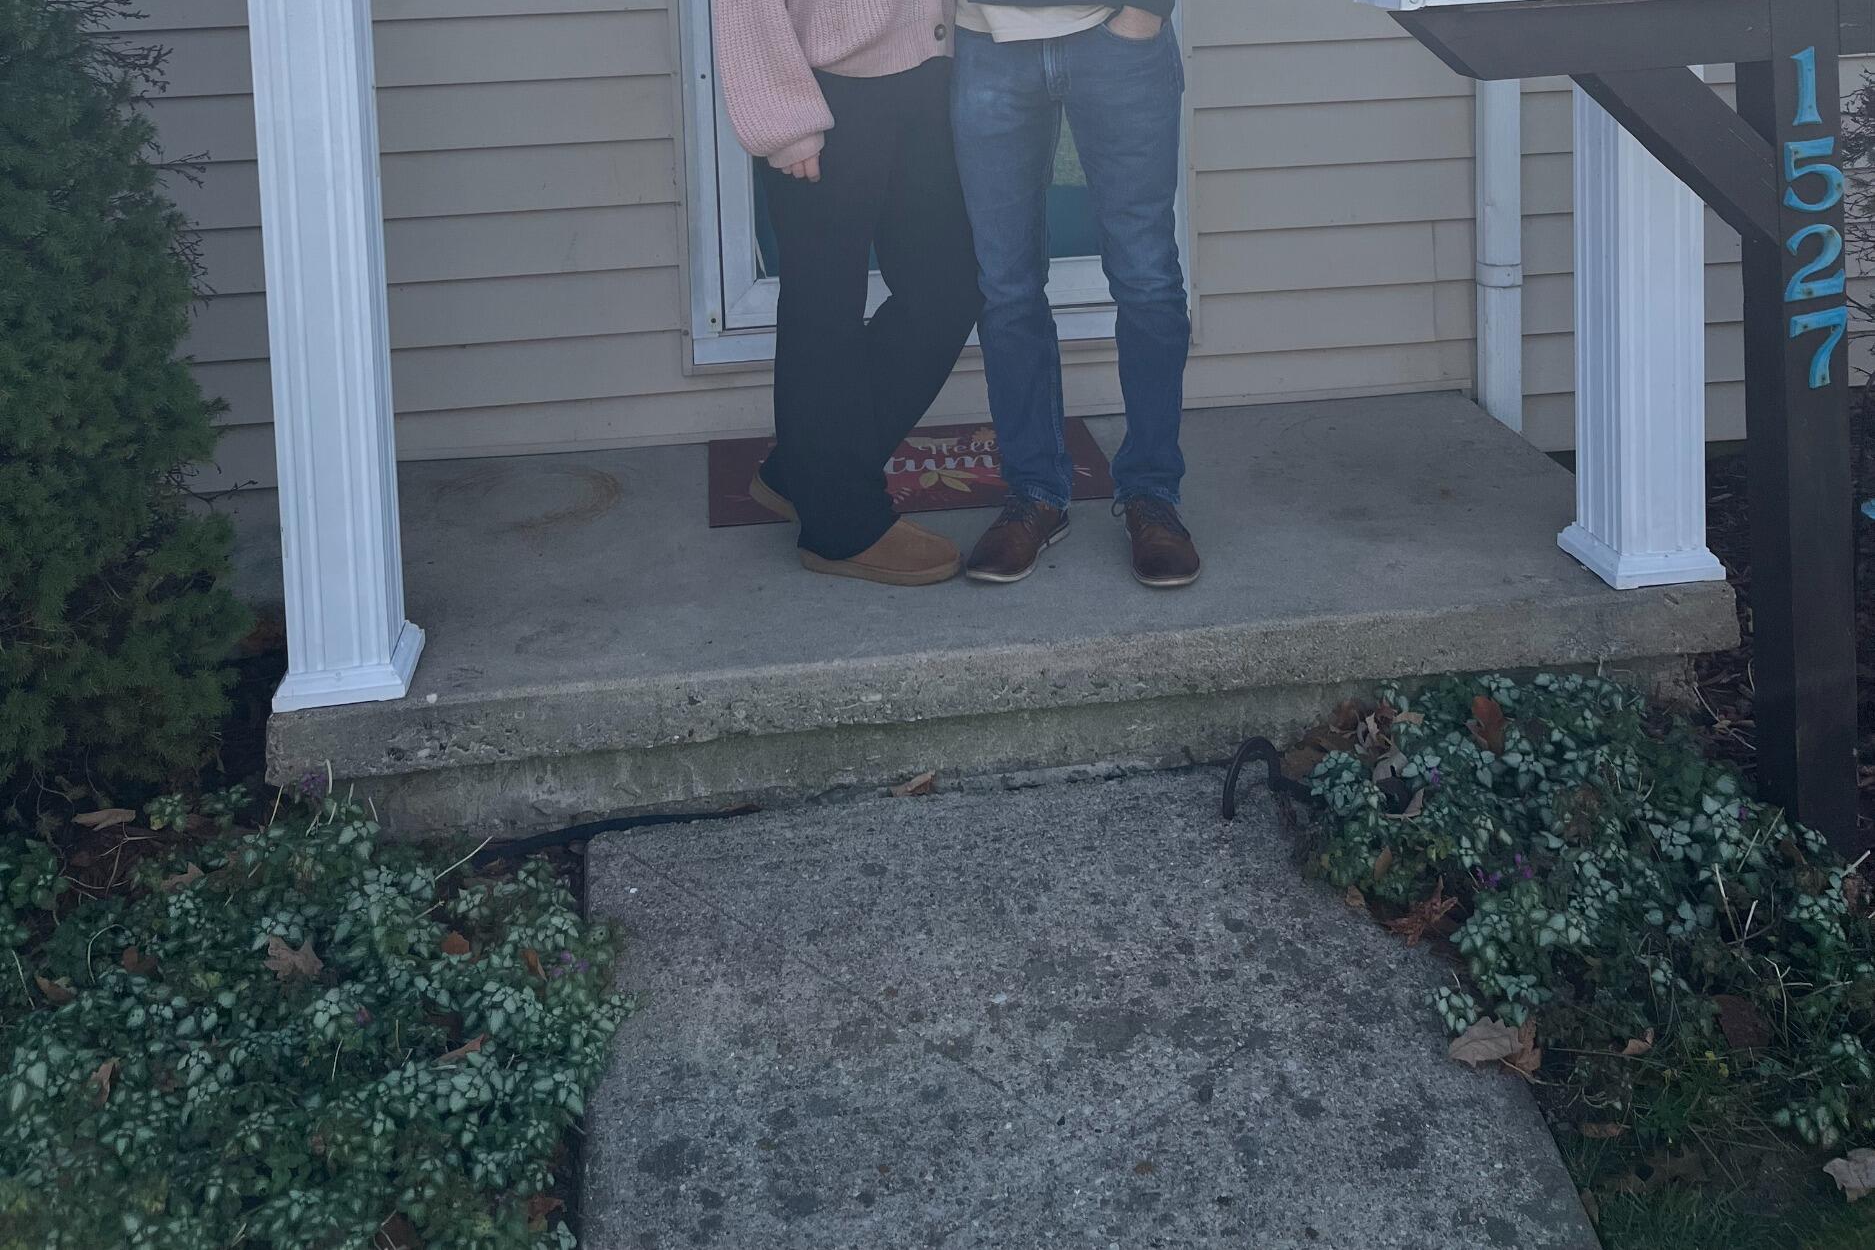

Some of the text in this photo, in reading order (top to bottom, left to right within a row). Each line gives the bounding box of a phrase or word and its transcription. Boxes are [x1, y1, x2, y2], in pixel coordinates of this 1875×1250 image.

[1784, 46, 1848, 388] 1527
[917, 439, 1000, 456] Hell
[883, 454, 1001, 475] tum
